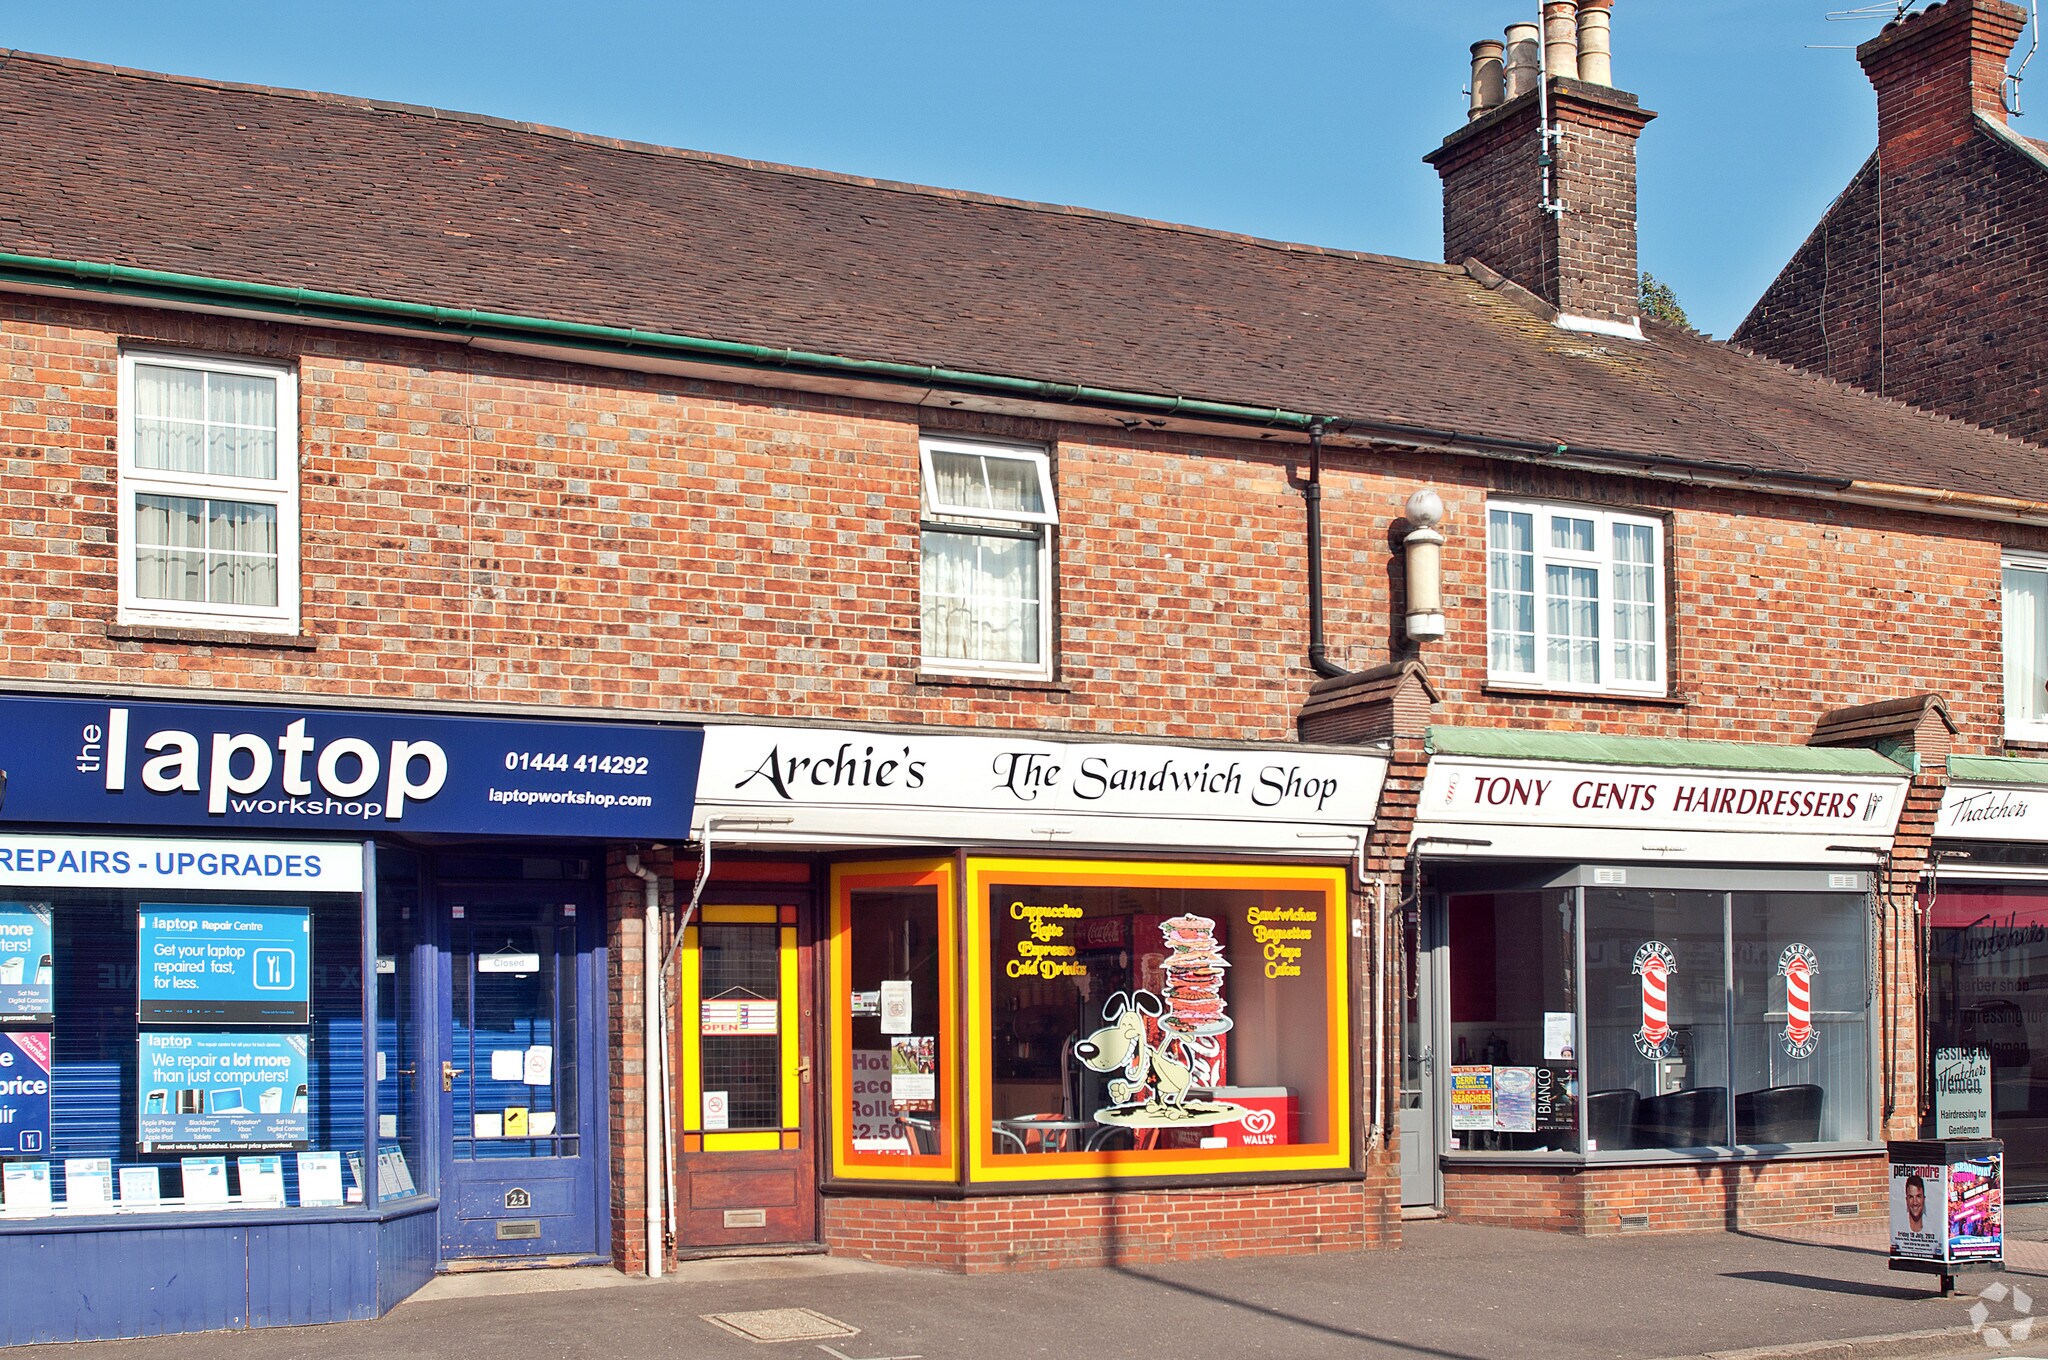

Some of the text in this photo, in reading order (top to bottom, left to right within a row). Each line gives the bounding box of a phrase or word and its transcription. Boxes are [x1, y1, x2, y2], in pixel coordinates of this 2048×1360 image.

[76, 723, 102, 774] the
[105, 707, 448, 819] laptop
[504, 751, 649, 775] 01444 414292
[734, 742, 926, 800] Archie's
[991, 751, 1338, 812] The Sandwich Shop
[489, 787, 652, 807] laptopworkshop.com
[1473, 776, 1859, 819] TONY GENTS HAIRDRESSERS
[231, 797, 382, 820] workshop
[0, 848, 131, 874] REPAIRS
[155, 852, 322, 878] UPGRADES
[1010, 901, 1084, 922] Cappuccino
[1246, 906, 1317, 925] Sandwiches
[154, 916, 263, 932] laptop Repair Centre
[1029, 920, 1064, 942] Latte
[1252, 925, 1312, 944] Baguettes
[153, 943, 246, 960] Get your laptop
[1017, 940, 1076, 961] Espresso
[1263, 943, 1302, 963] Crisps
[1634, 942, 1674, 966] BARBER
[1779, 944, 1818, 967] BARBER
[153, 960, 205, 975] repaired
[210, 961, 236, 975] fast,
[493, 958, 525, 967] Closed
[1006, 959, 1087, 979] Cold Drinks
[1264, 961, 1301, 979] Cakes
[153, 976, 199, 989] for less.
[21, 1036, 46, 1062] Promise
[149, 1034, 192, 1049] laptop
[1786, 1042, 1813, 1057] SHOP
[152, 1052, 291, 1069] We repair a lot more
[852, 1053, 890, 1070] Hot
[153, 1069, 289, 1086] than just computers!
[853, 1080, 892, 1094] aco
[1452, 1094, 1491, 1103] SEARCHERS
[1537, 1068, 1552, 1114] BIANCO
[1940, 1109, 1987, 1121] Hairdressing for
[1242, 1134, 1274, 1145] WALL'S
[1948, 1125, 1980, 1135] Gentlemen
[510, 1194, 525, 1206] 23
